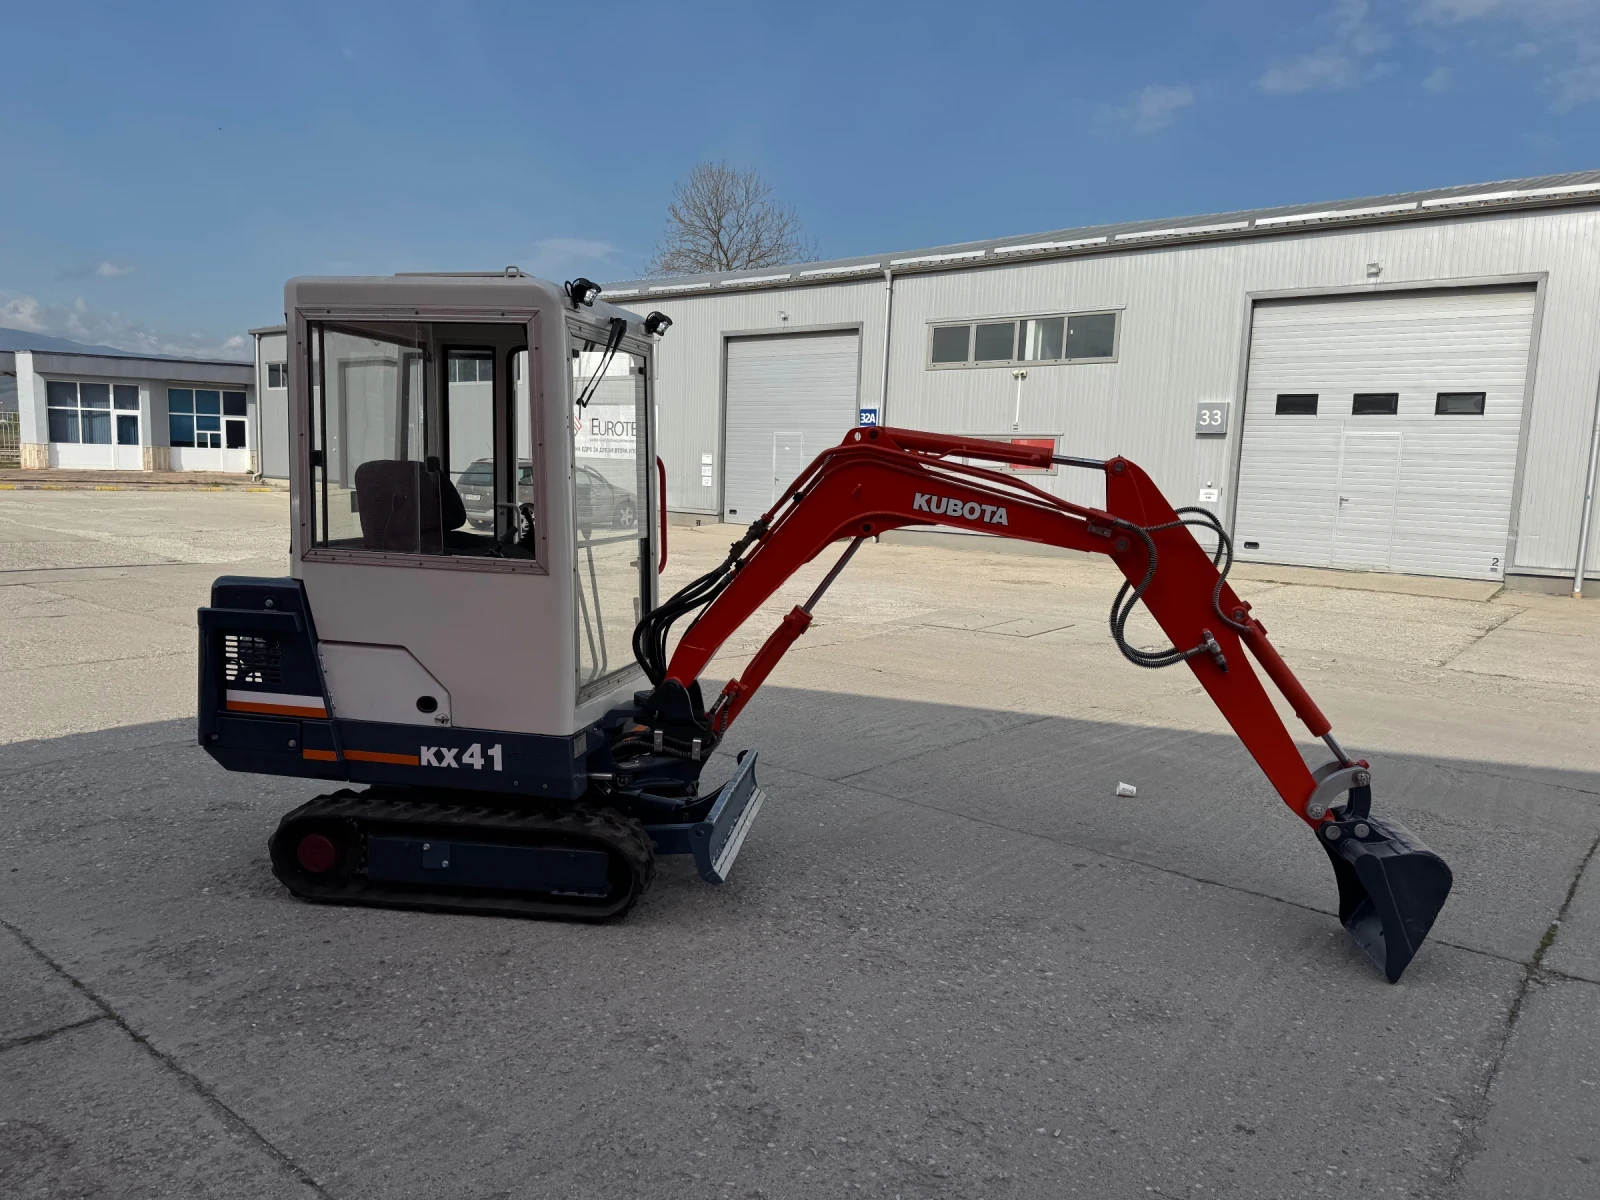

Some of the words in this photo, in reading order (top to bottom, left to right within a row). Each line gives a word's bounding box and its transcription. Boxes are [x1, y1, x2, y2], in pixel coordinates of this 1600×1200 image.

[860, 413, 876, 423] 32A
[1199, 410, 1222, 426] 33
[912, 492, 1009, 526] KUBOTA
[1491, 557, 1499, 567] 2
[420, 743, 503, 772] KX41
